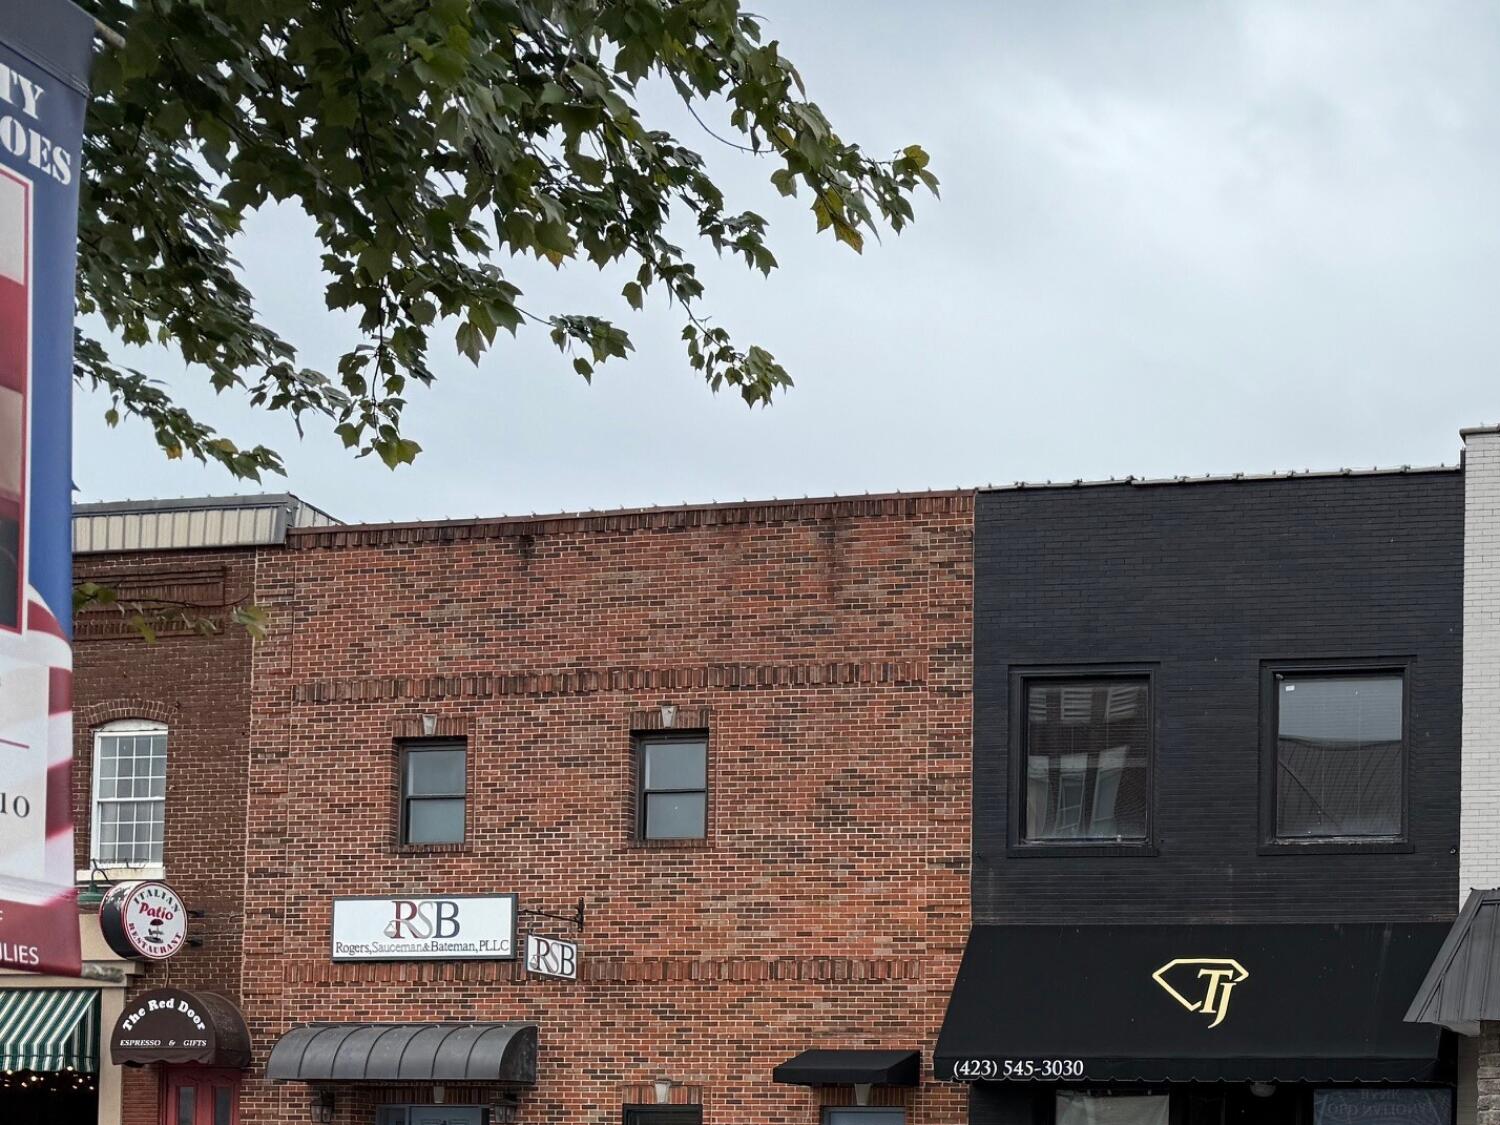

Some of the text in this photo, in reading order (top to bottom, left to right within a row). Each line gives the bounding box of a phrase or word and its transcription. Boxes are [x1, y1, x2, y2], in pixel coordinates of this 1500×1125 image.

[133, 889, 179, 913] ITALIAN
[139, 902, 174, 920] Patio
[385, 900, 460, 939] RSB
[128, 922, 182, 954] RESTAURANT
[530, 938, 575, 976] RSB
[122, 998, 206, 1031] The Red Door
[953, 1060, 1084, 1077] (423) 545-3030
